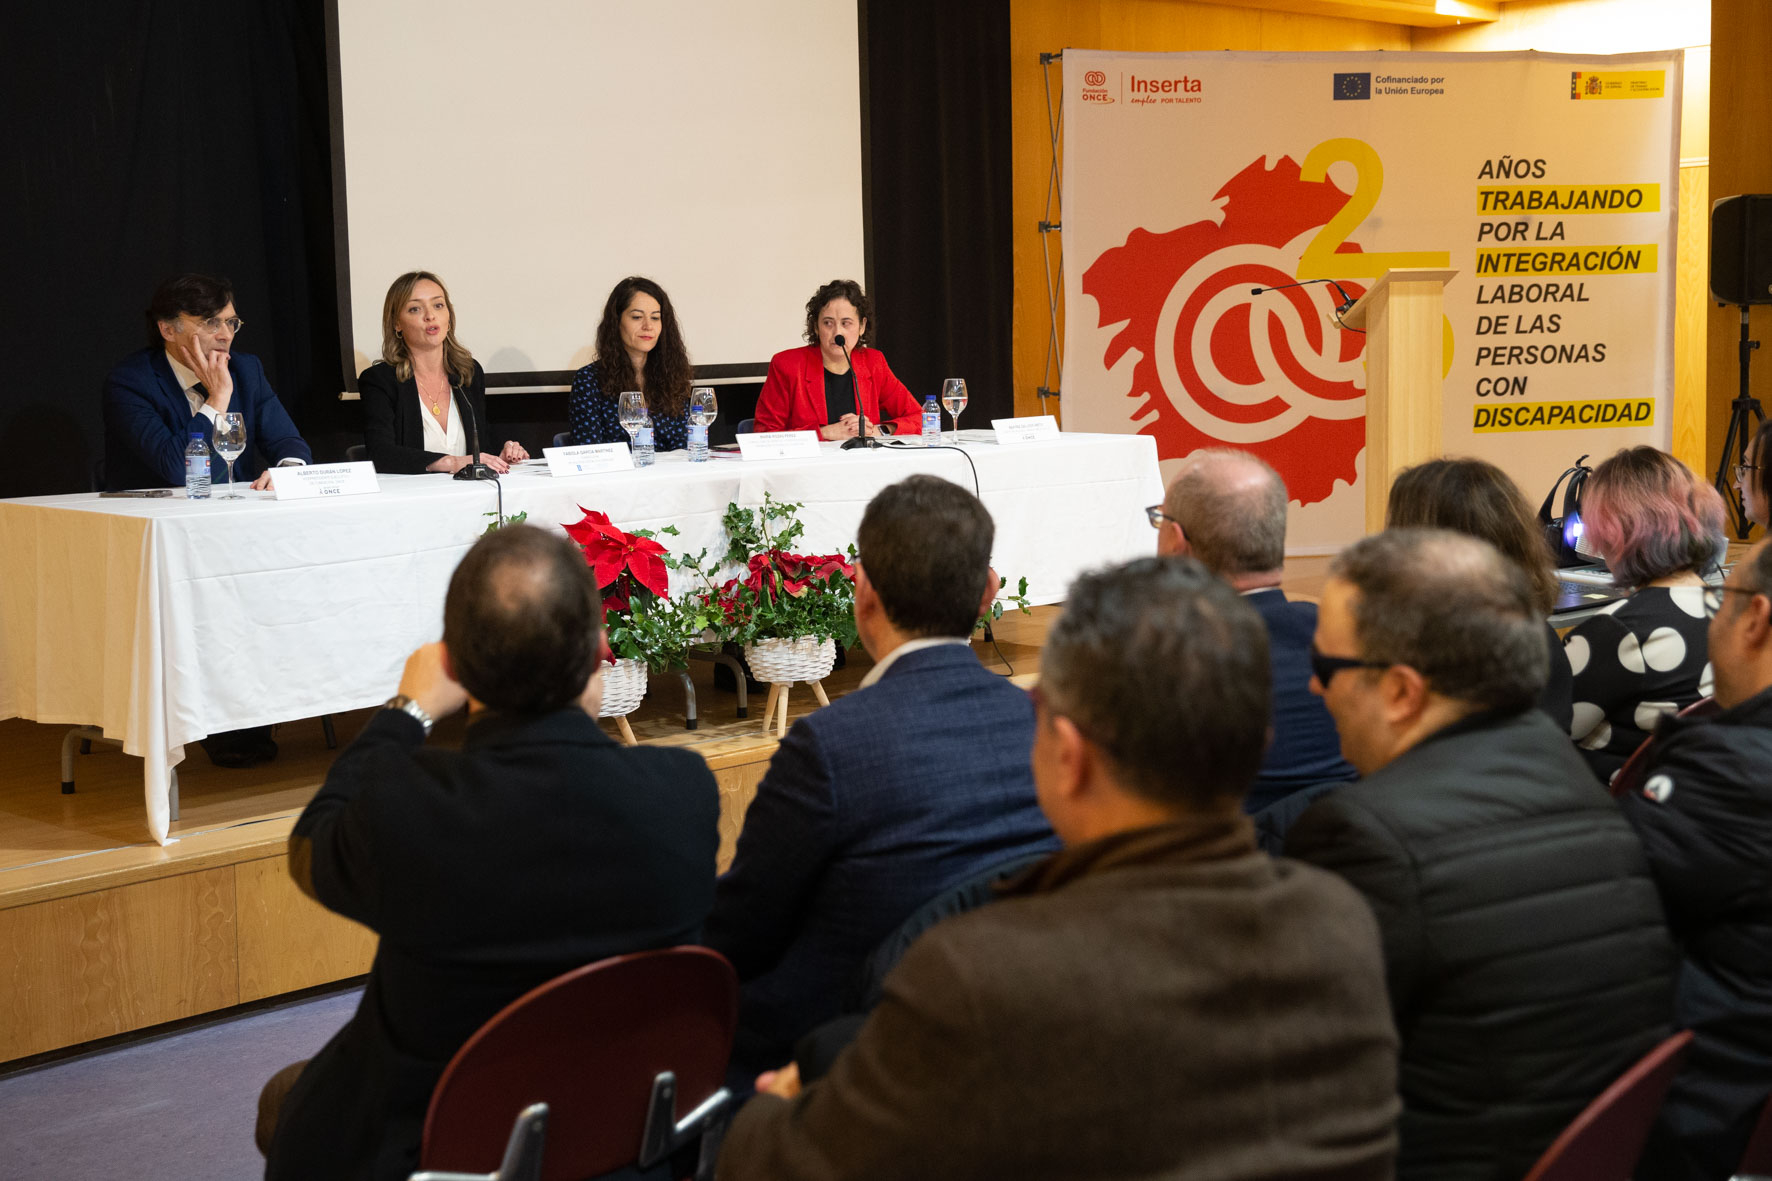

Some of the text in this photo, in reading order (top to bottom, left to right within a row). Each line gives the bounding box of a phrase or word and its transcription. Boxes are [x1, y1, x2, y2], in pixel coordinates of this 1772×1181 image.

[1131, 75, 1202, 93] Inserta
[1375, 76, 1445, 85] Cofinanciado por
[1131, 95, 1157, 107] empleo
[1375, 87, 1444, 96] la Unión Europea
[1477, 155, 1547, 180] AÑOS
[1480, 188, 1643, 211] TRABAJANDO
[1477, 221, 1566, 242] POR LA
[1476, 246, 1641, 273] INTEGRACIÓN
[1476, 282, 1590, 305] LABORAL
[1475, 314, 1562, 335] DE LAS
[1475, 343, 1607, 366] PERSONAS
[1475, 376, 1528, 397] CON
[1473, 402, 1651, 428] DISCAPACIDAD
